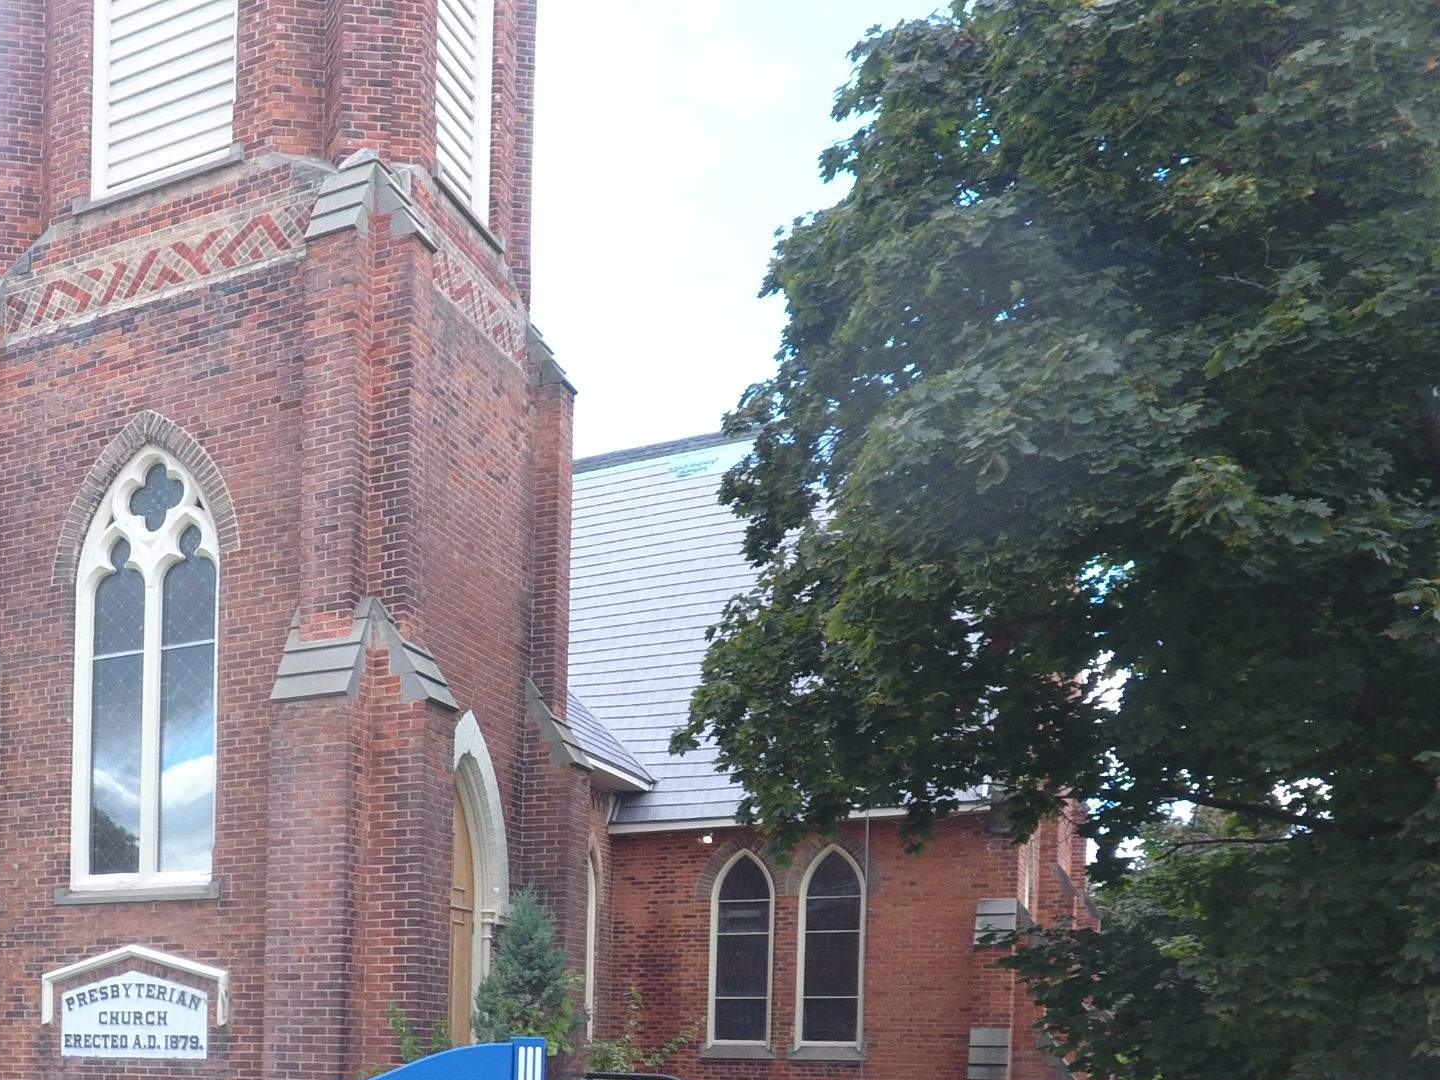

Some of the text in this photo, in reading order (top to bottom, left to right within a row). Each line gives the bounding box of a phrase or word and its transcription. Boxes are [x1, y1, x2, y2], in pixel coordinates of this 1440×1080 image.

[64, 983, 202, 1012] PRESBYTERIAN
[98, 1011, 169, 1026] CHURCH
[64, 1033, 128, 1050] ERECTED
[132, 1034, 161, 1050] A.D.
